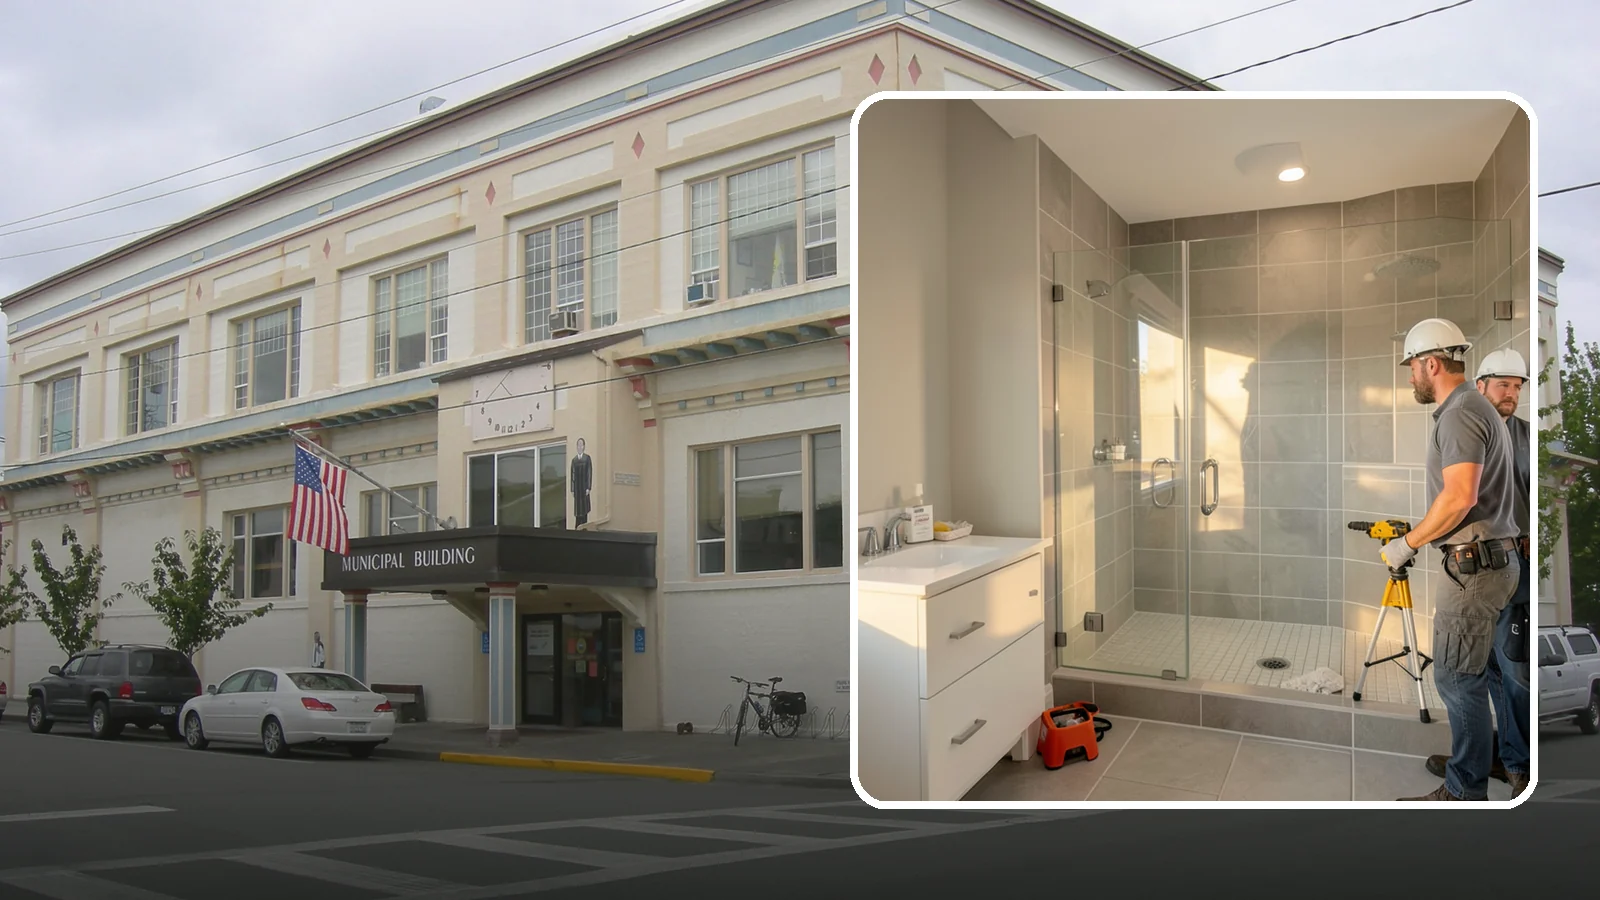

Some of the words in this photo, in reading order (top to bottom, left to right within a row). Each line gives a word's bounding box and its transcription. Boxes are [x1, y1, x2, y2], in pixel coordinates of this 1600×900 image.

[476, 390, 479, 398] 7
[480, 407, 484, 415] 8
[488, 418, 492, 426] 9
[529, 414, 532, 422] 3
[342, 552, 404, 572] MUNICIPAL
[414, 546, 475, 566] BUILDING
